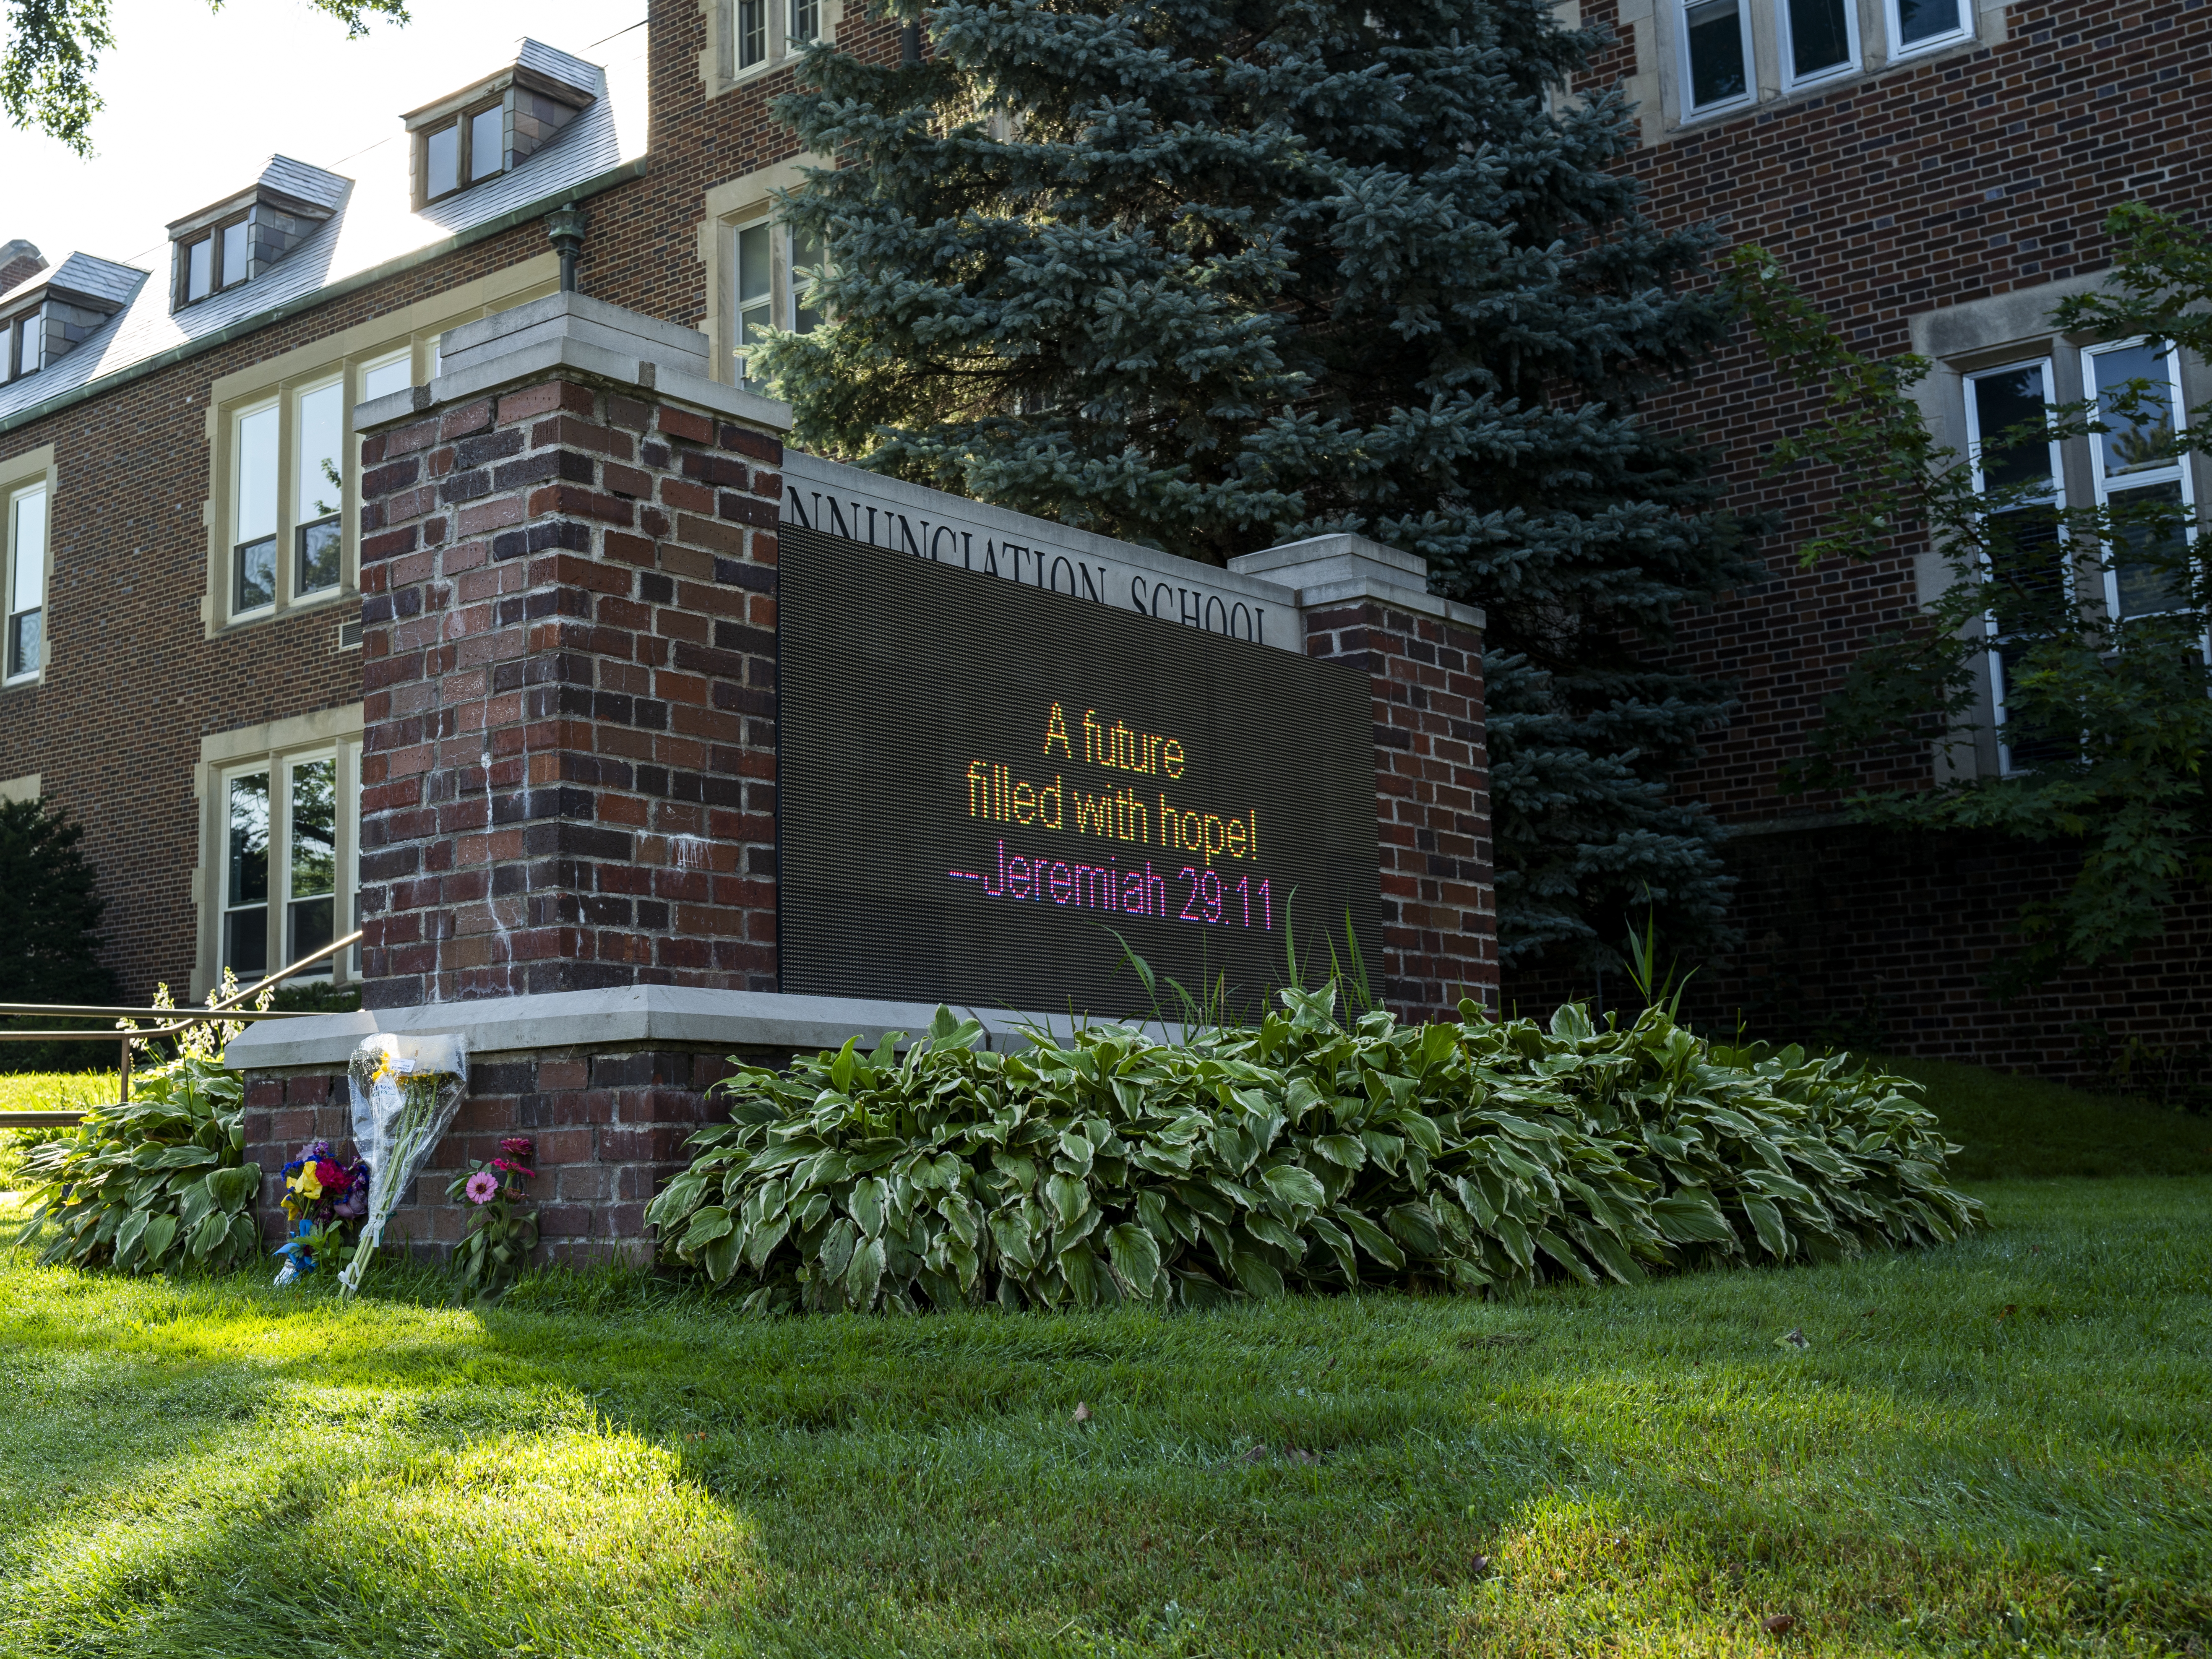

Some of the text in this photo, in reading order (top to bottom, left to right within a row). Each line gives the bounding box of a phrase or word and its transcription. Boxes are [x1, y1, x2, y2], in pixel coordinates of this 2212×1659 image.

[787, 486, 1106, 604] NNUNCIATION
[1044, 702, 1184, 779] A future
[966, 760, 1256, 865] filled with hope!
[1178, 867, 1270, 930] 29:11
